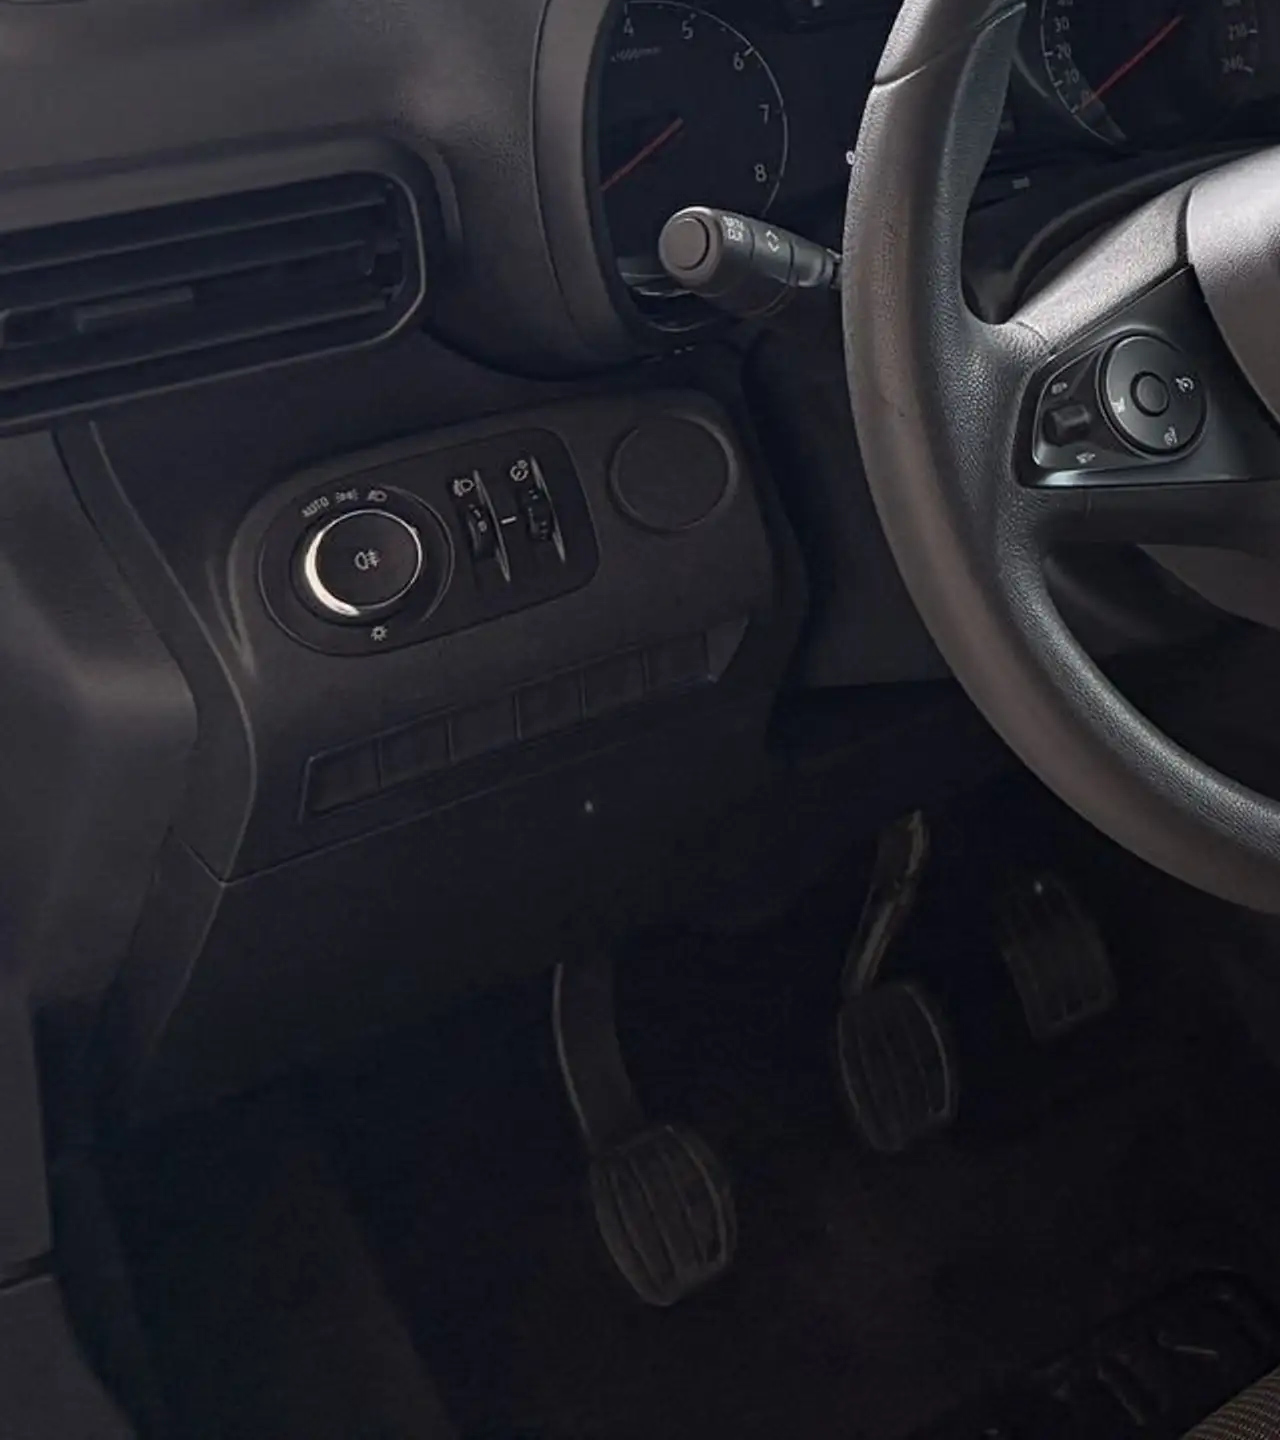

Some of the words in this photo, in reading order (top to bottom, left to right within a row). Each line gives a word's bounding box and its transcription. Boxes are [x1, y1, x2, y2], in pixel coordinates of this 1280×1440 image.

[623, 17, 635, 37] 4
[682, 20, 694, 40] 5
[1053, 16, 1070, 33] 30
[1056, 41, 1072, 60] 20
[733, 52, 745, 71] 6
[1221, 55, 1244, 73] 240
[1064, 68, 1080, 84] 10
[758, 103, 770, 124] 7
[754, 163, 768, 183] 8
[301, 495, 330, 518] AUTO
